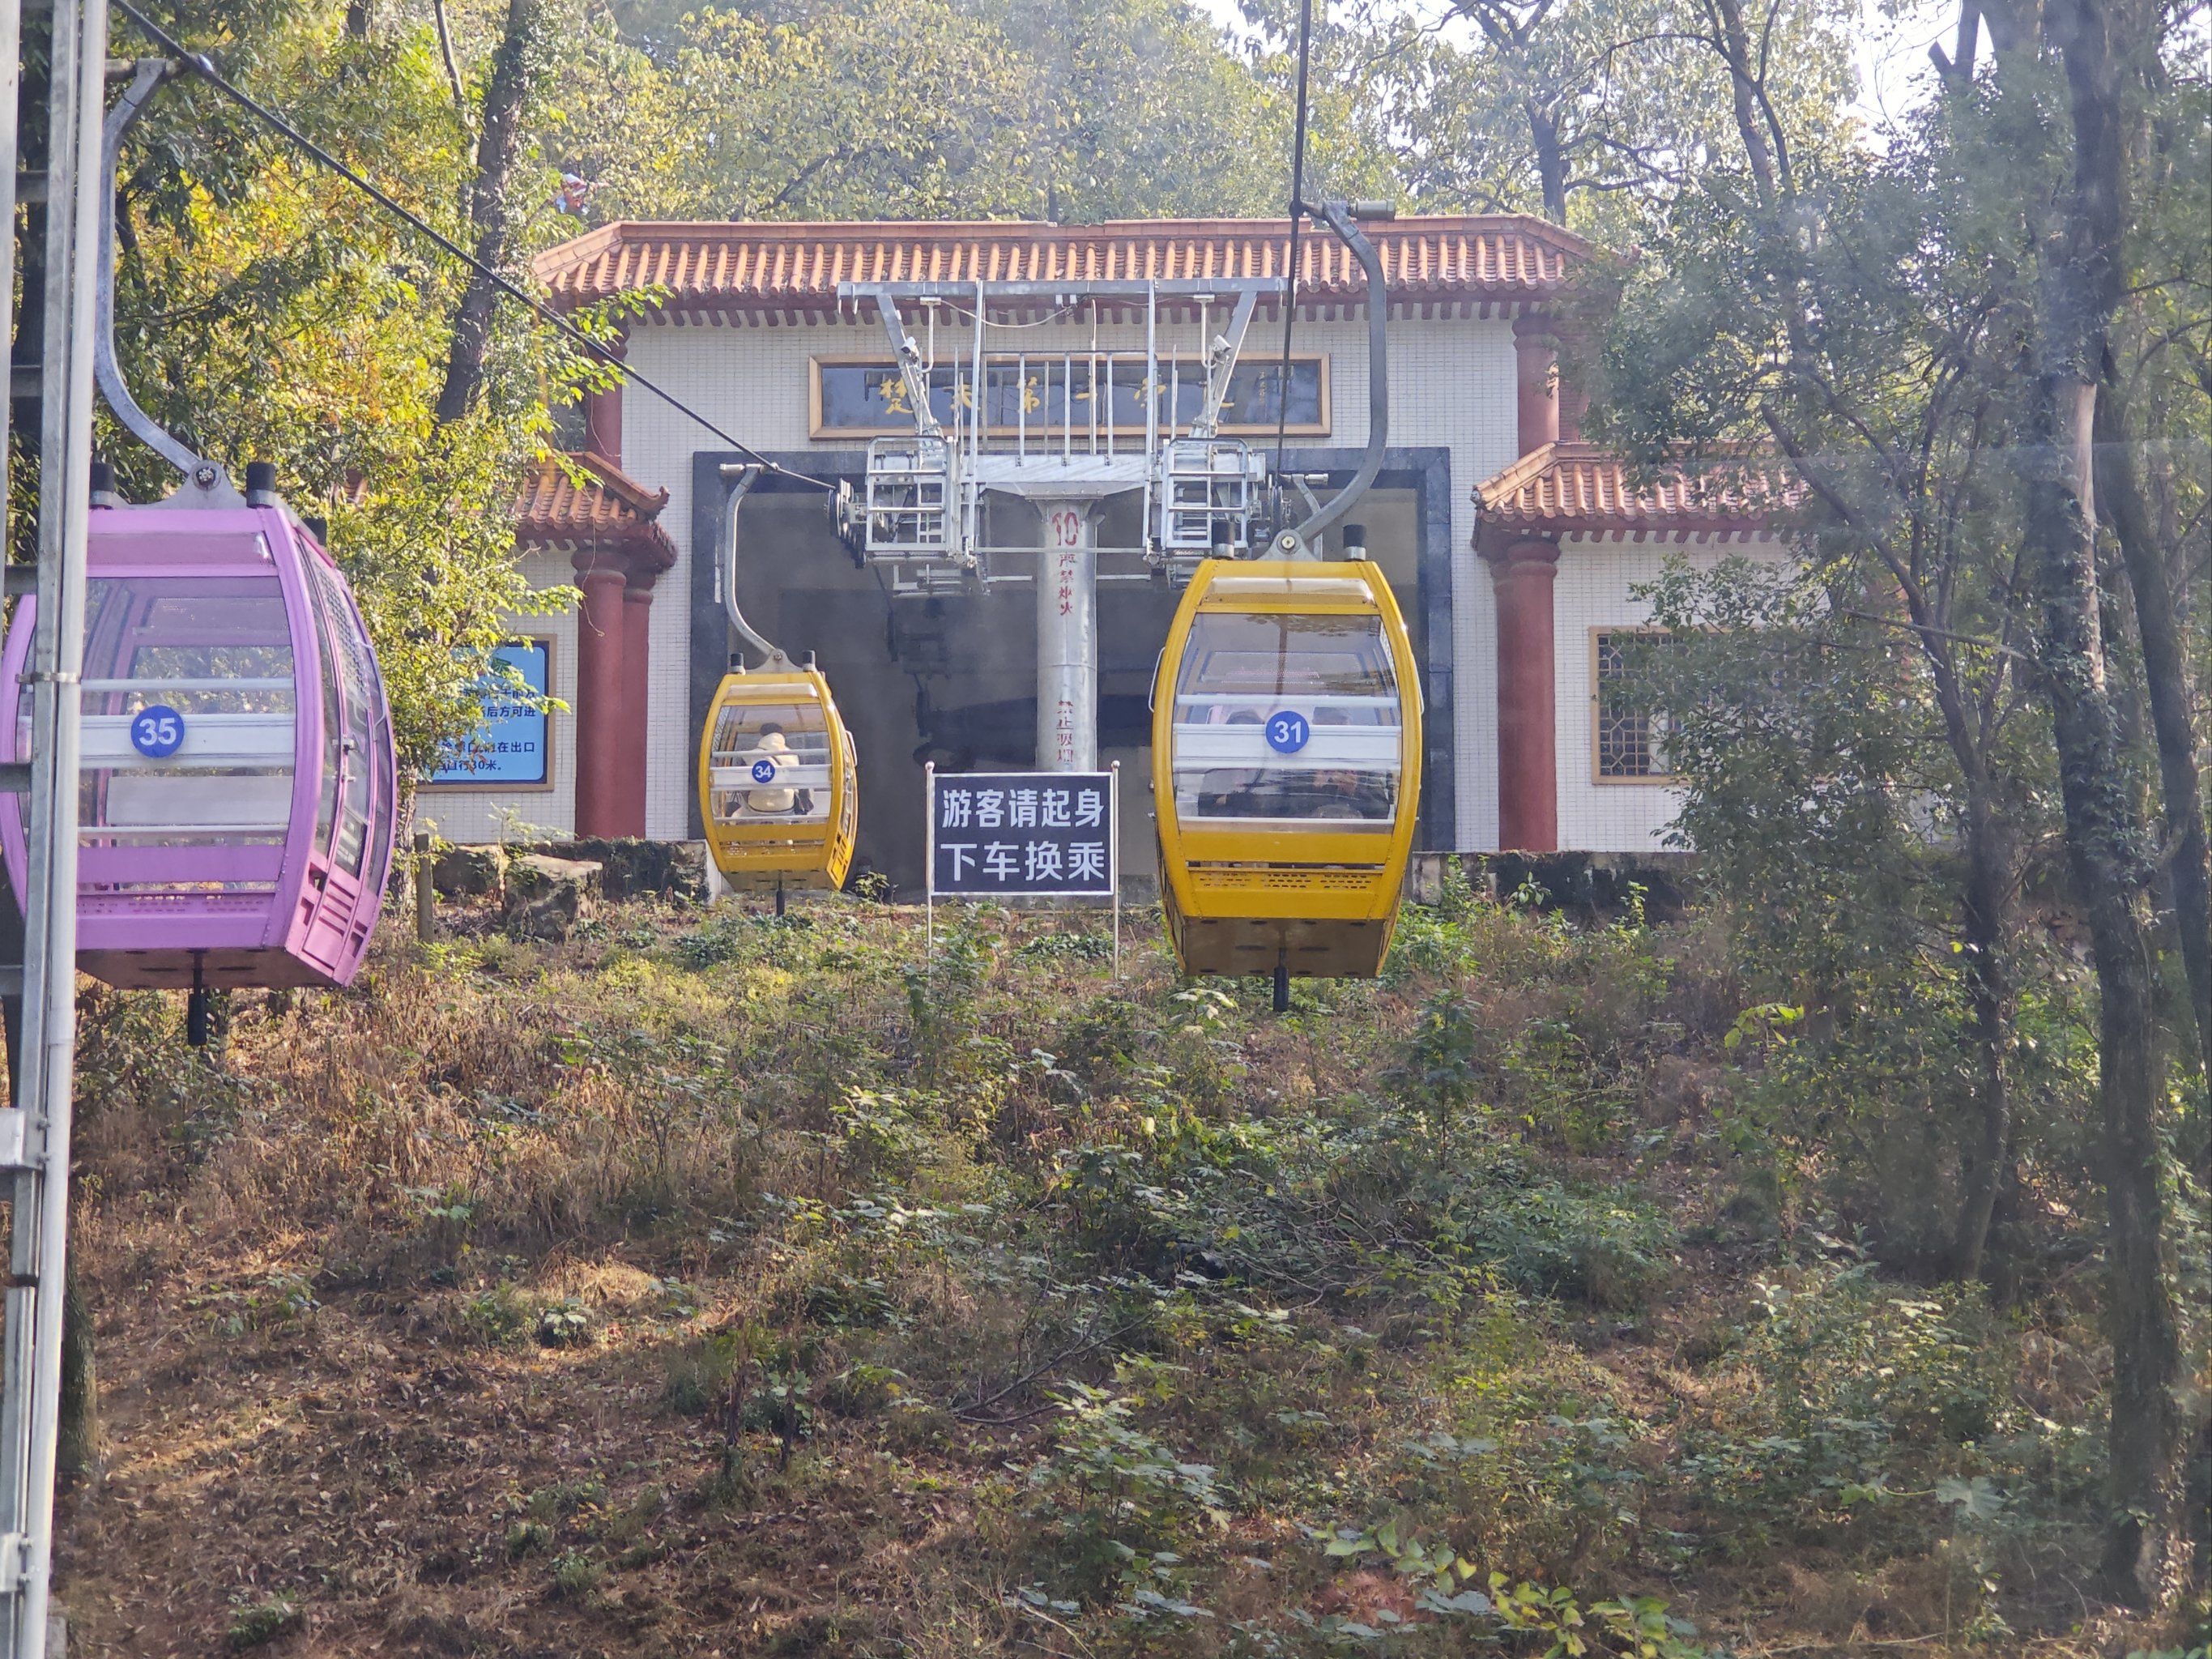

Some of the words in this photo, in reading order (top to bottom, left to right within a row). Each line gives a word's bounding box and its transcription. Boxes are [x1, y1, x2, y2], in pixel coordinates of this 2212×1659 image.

[1051, 511, 1079, 546] 10
[139, 717, 177, 746] 35
[1273, 720, 1302, 744] 31
[755, 765, 773, 778] 34
[941, 788, 1105, 829] 游客请起身
[940, 841, 1106, 882] 下车换乘
